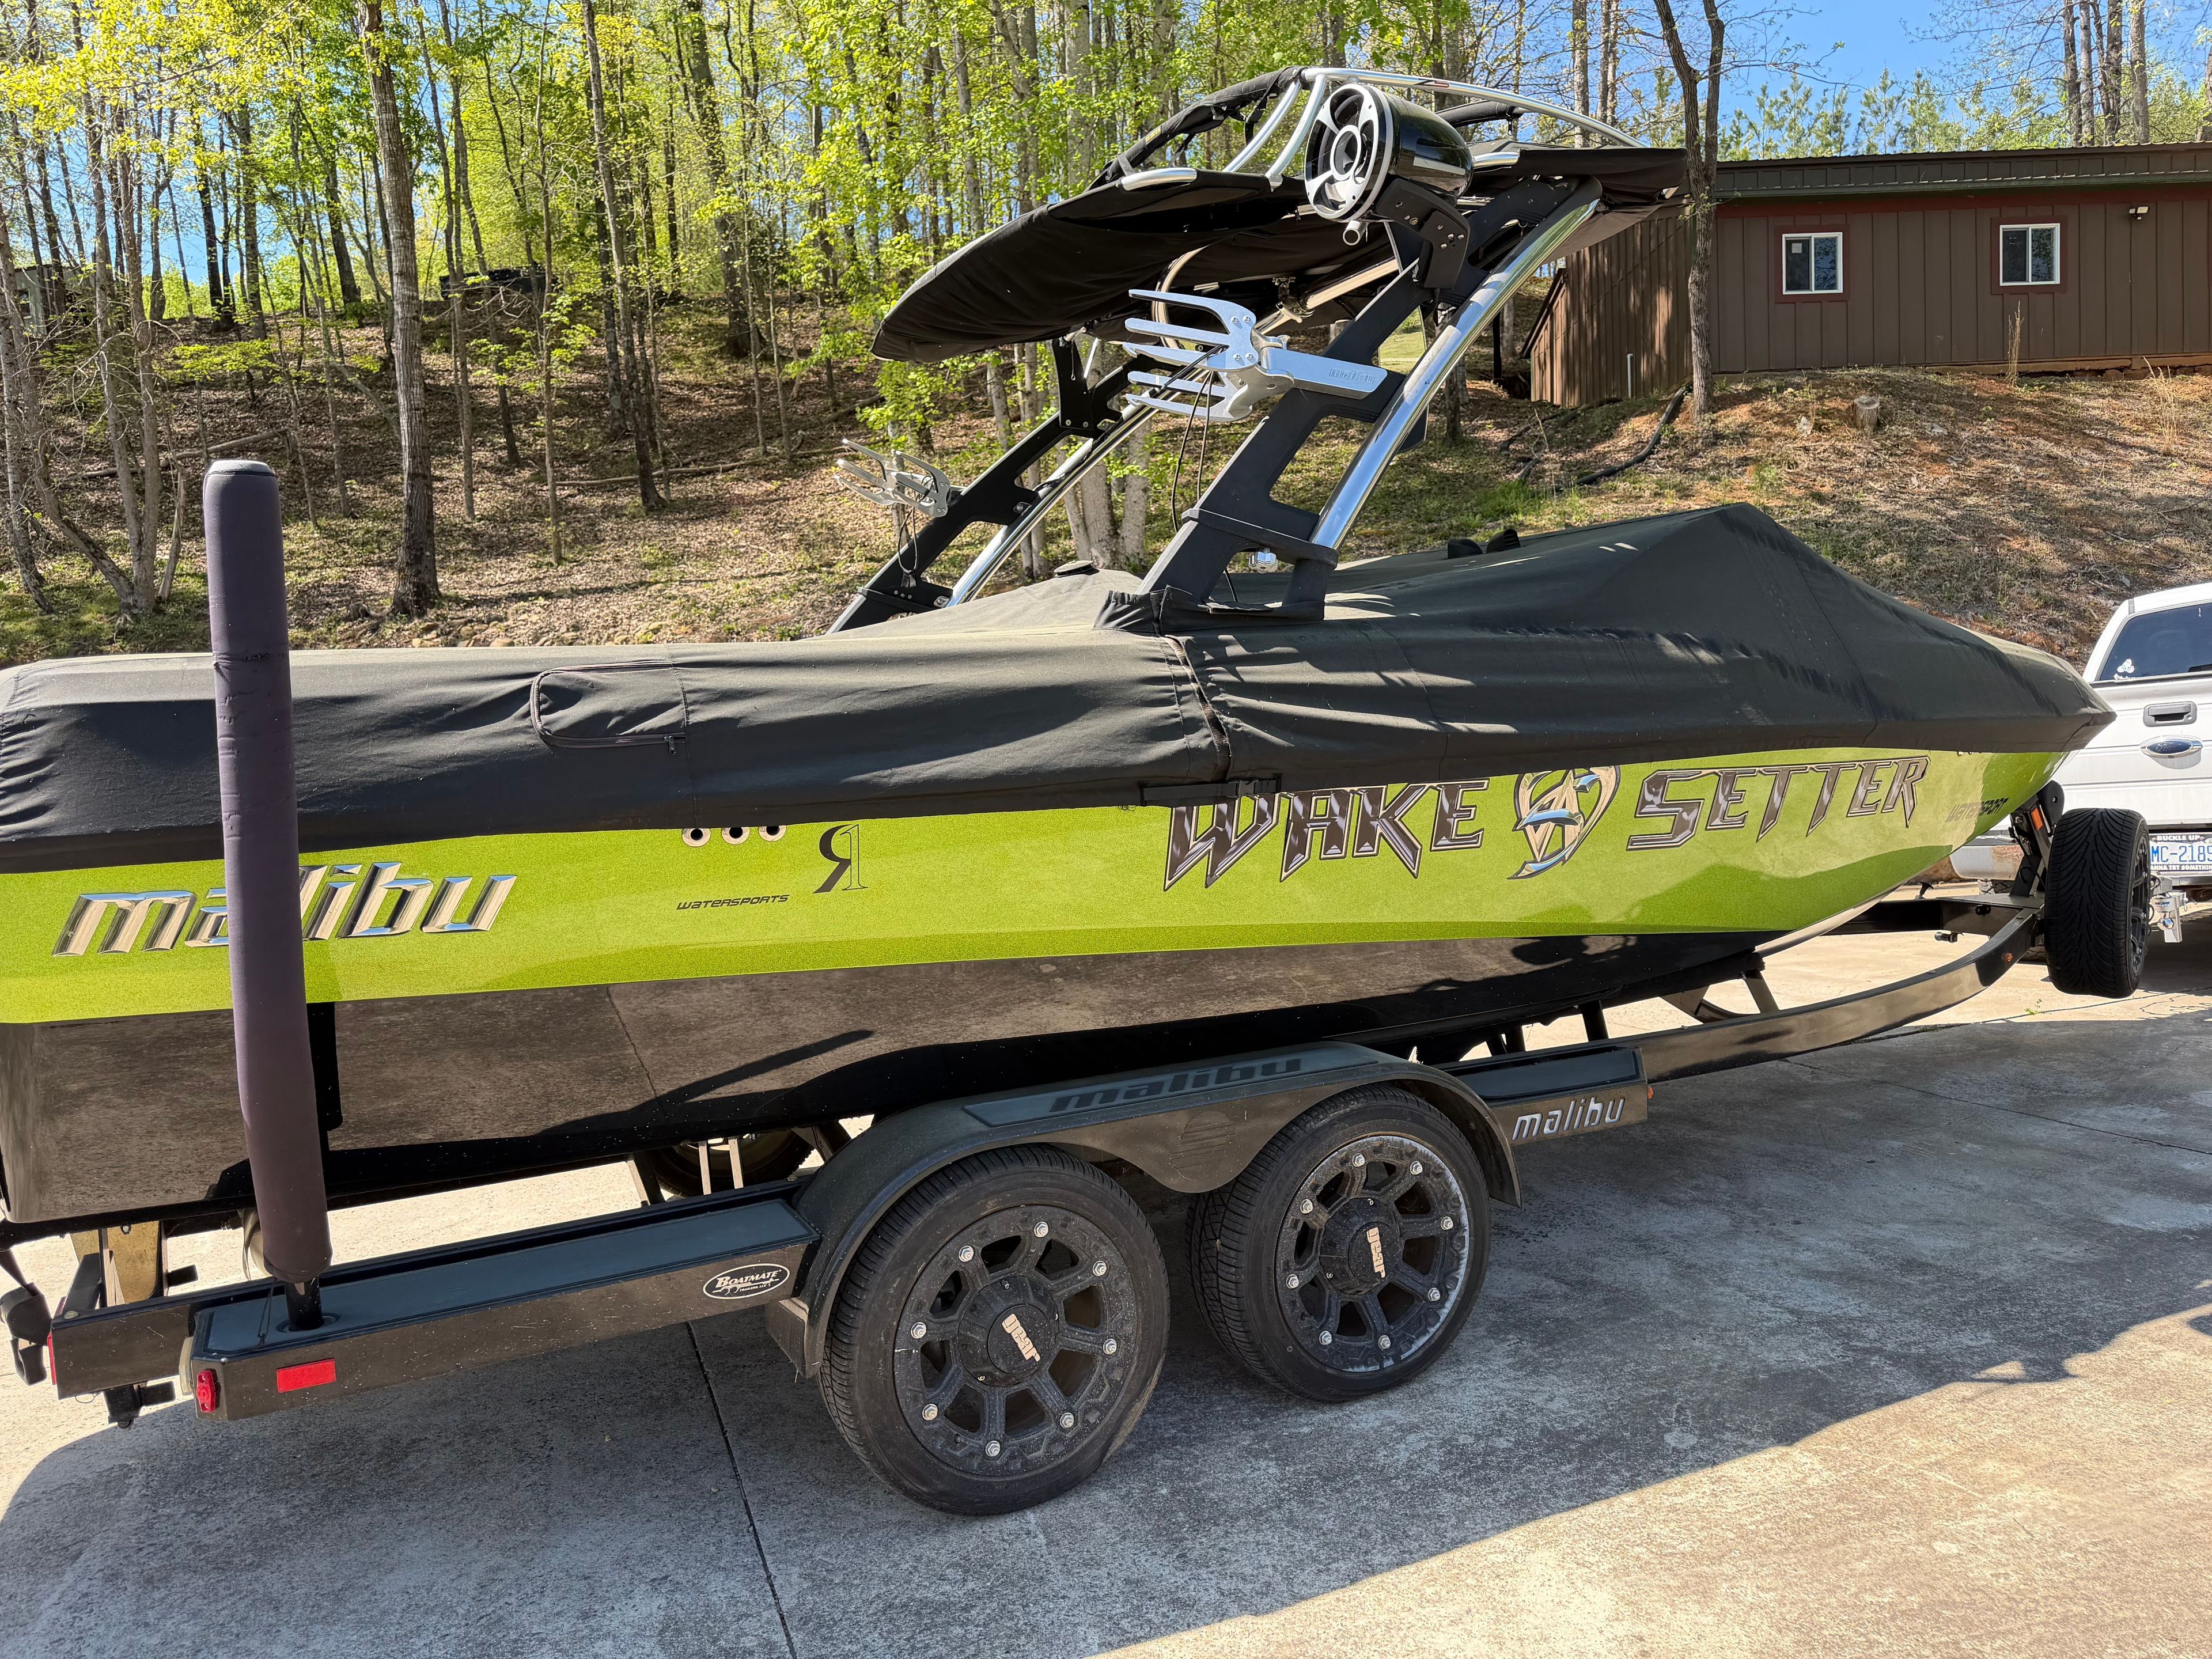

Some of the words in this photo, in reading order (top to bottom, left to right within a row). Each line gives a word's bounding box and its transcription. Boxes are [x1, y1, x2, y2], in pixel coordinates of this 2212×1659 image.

[1328, 368, 1376, 384] malibu
[1163, 779, 1490, 892] WAKE
[1626, 755, 1931, 851] SETTER
[2151, 845, 2212, 862] MC-2189
[1048, 1058, 1301, 1113] malibu
[1512, 1097, 1626, 1141] malibu
[715, 1271, 779, 1288] BOATMATE
[1001, 1313, 1041, 1362] gear
